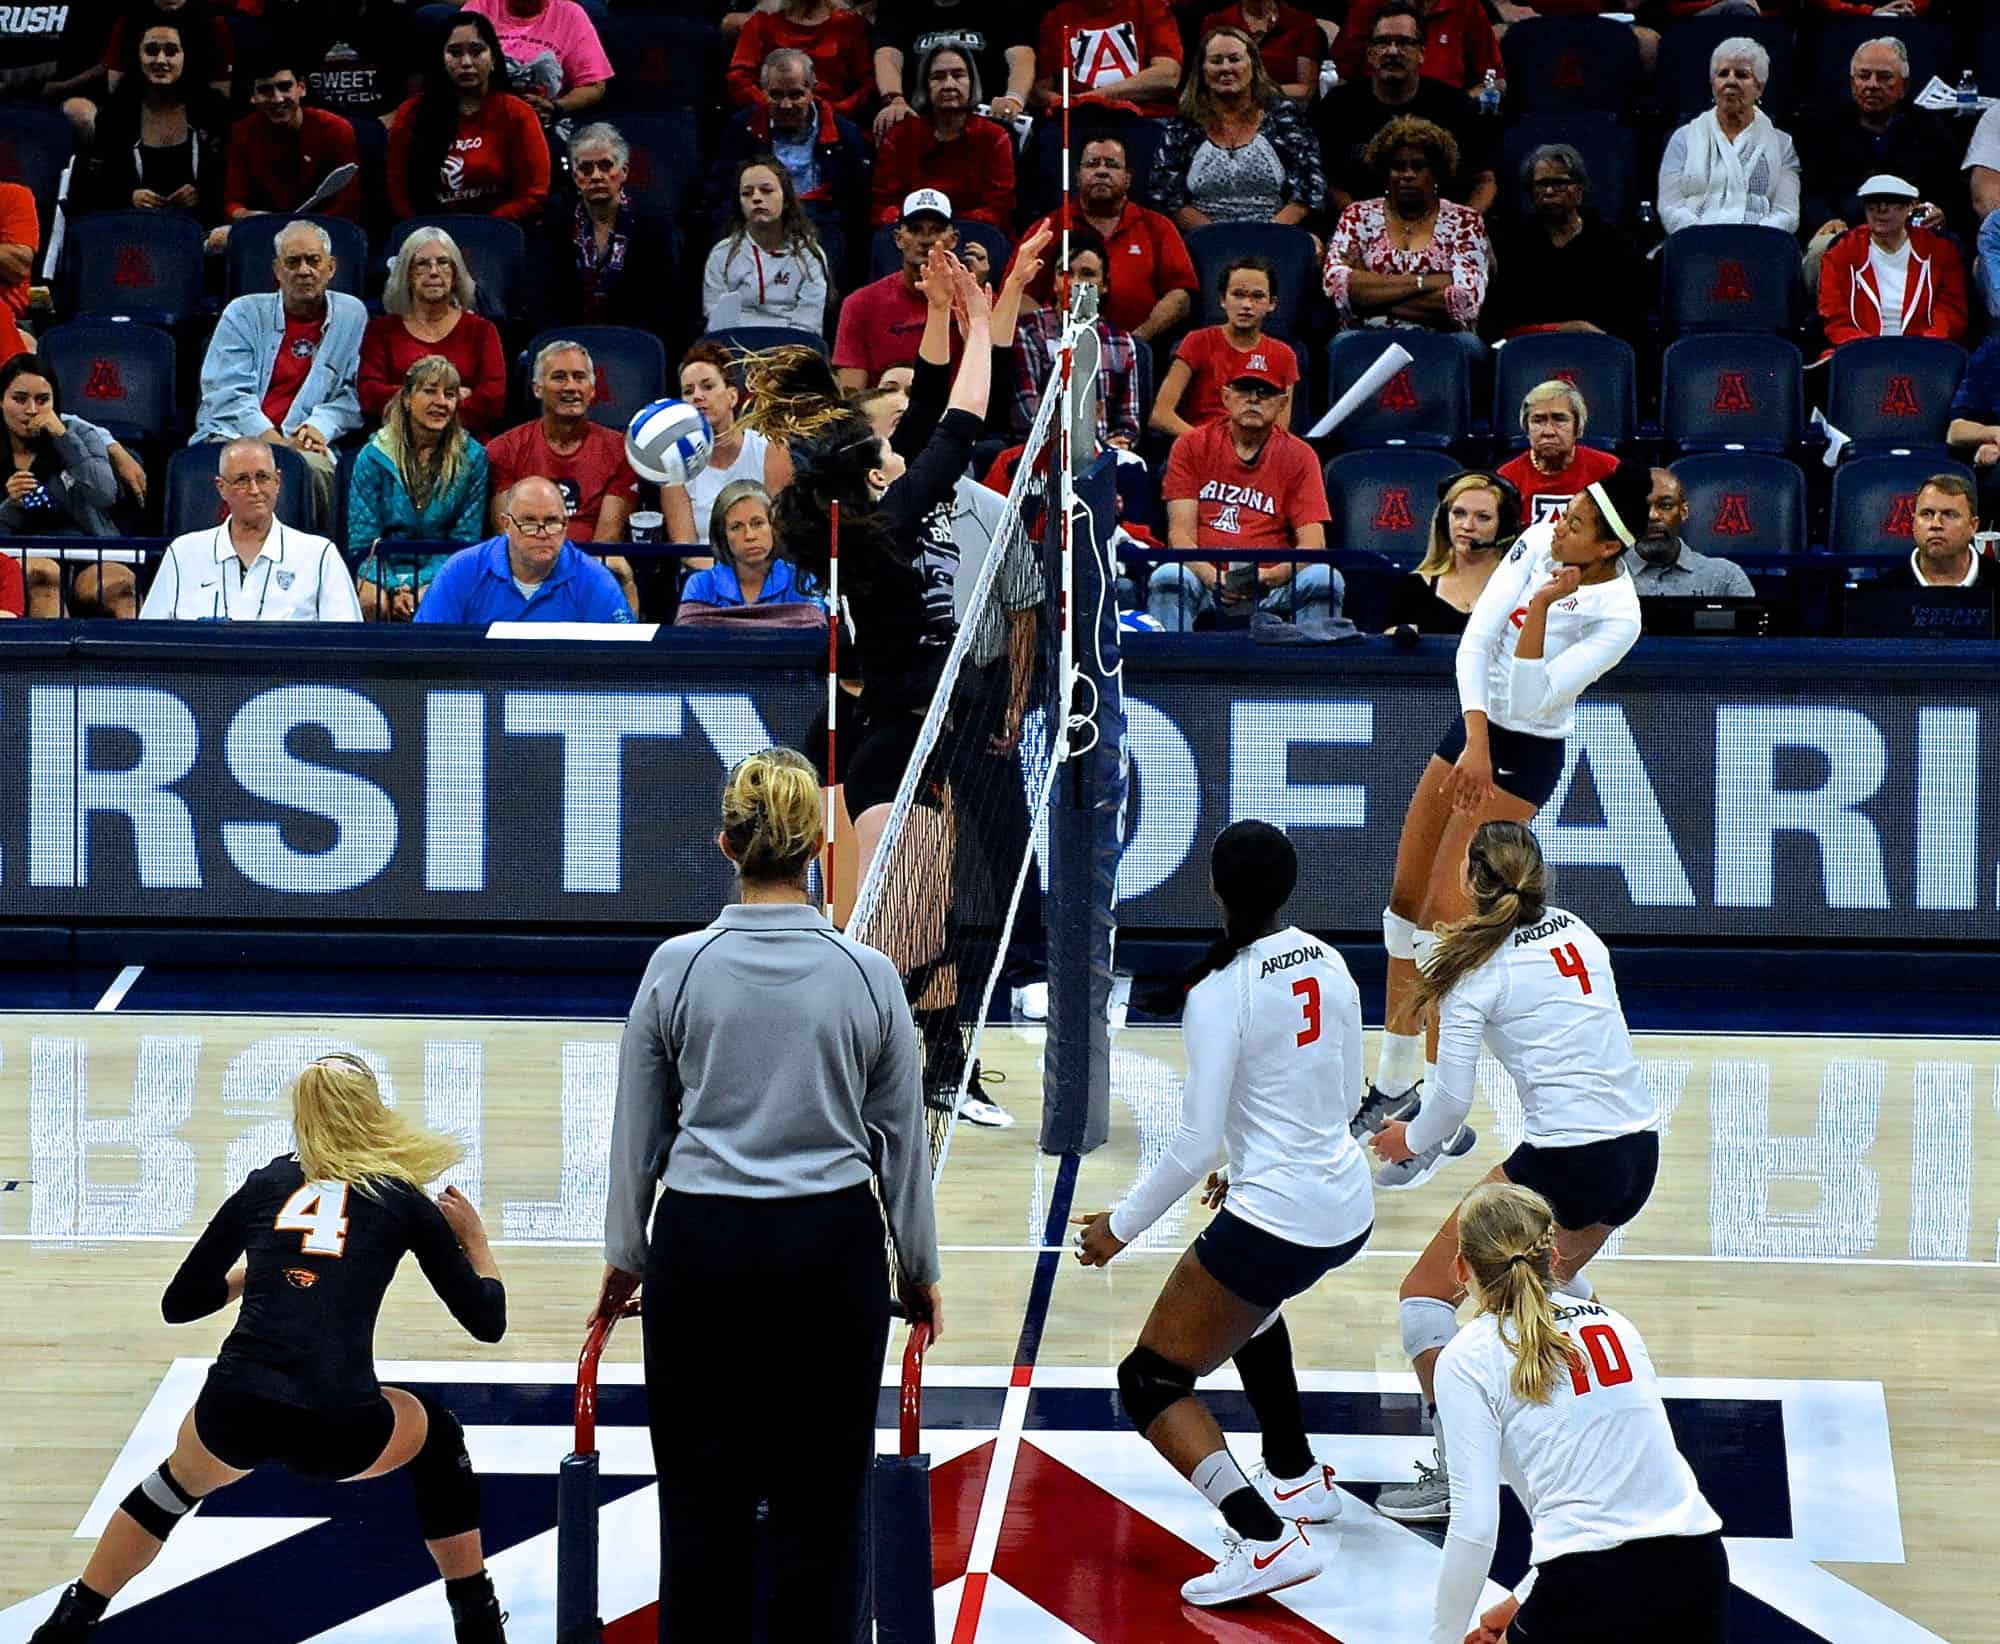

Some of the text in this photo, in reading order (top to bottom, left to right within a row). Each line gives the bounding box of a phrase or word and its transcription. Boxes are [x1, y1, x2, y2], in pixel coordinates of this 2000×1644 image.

[309, 69, 377, 89] SWEET
[0, 683, 778, 893] RSIT
[1530, 702, 2000, 909] ARI
[1260, 945, 1324, 979] ARIZONA
[1514, 915, 1574, 950] ARIZONA
[1550, 942, 1592, 995] 4
[1291, 976, 1321, 1048] 3
[274, 1178, 350, 1258] 4
[1562, 1323, 1634, 1397] 10
